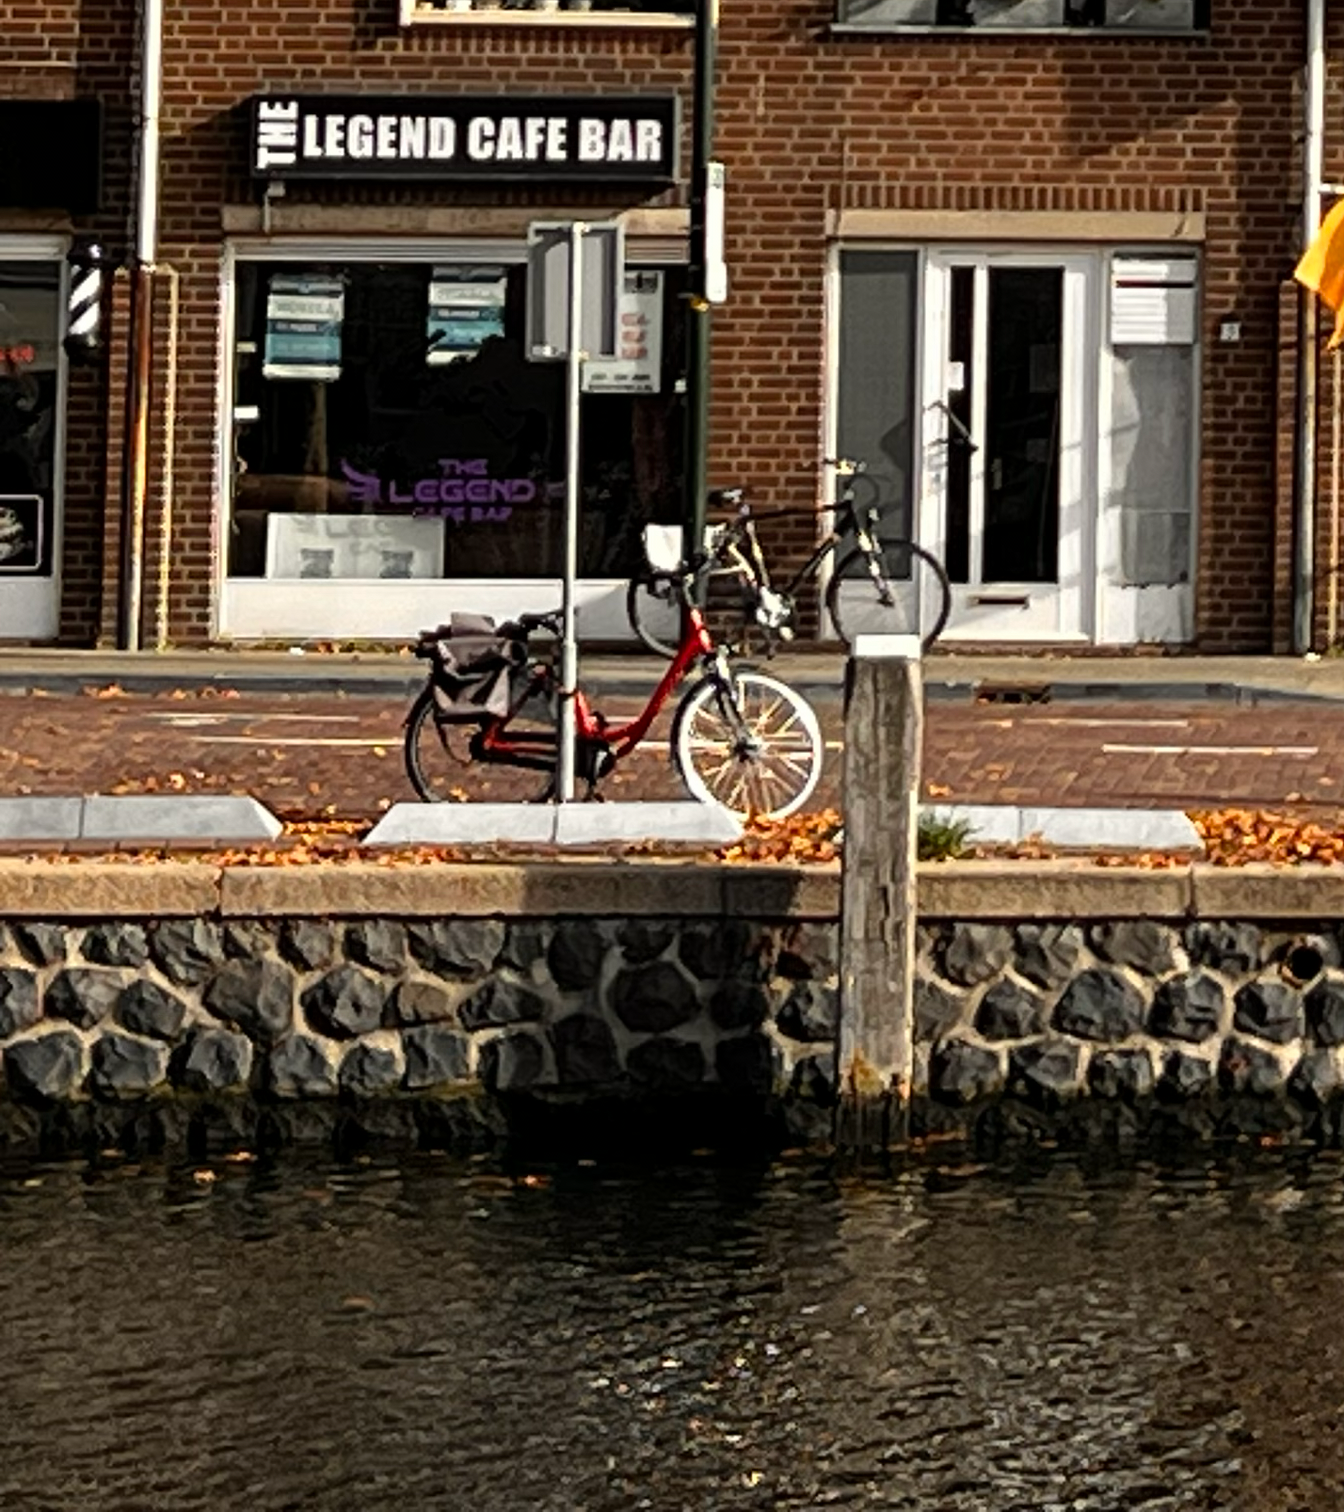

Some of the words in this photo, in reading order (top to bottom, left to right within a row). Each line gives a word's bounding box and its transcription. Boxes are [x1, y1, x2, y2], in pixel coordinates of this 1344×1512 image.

[257, 100, 299, 170] THE
[303, 114, 456, 159] LEGEND
[467, 116, 567, 161] CAFE
[578, 119, 662, 162] BAR
[389, 479, 536, 503] LEGEND
